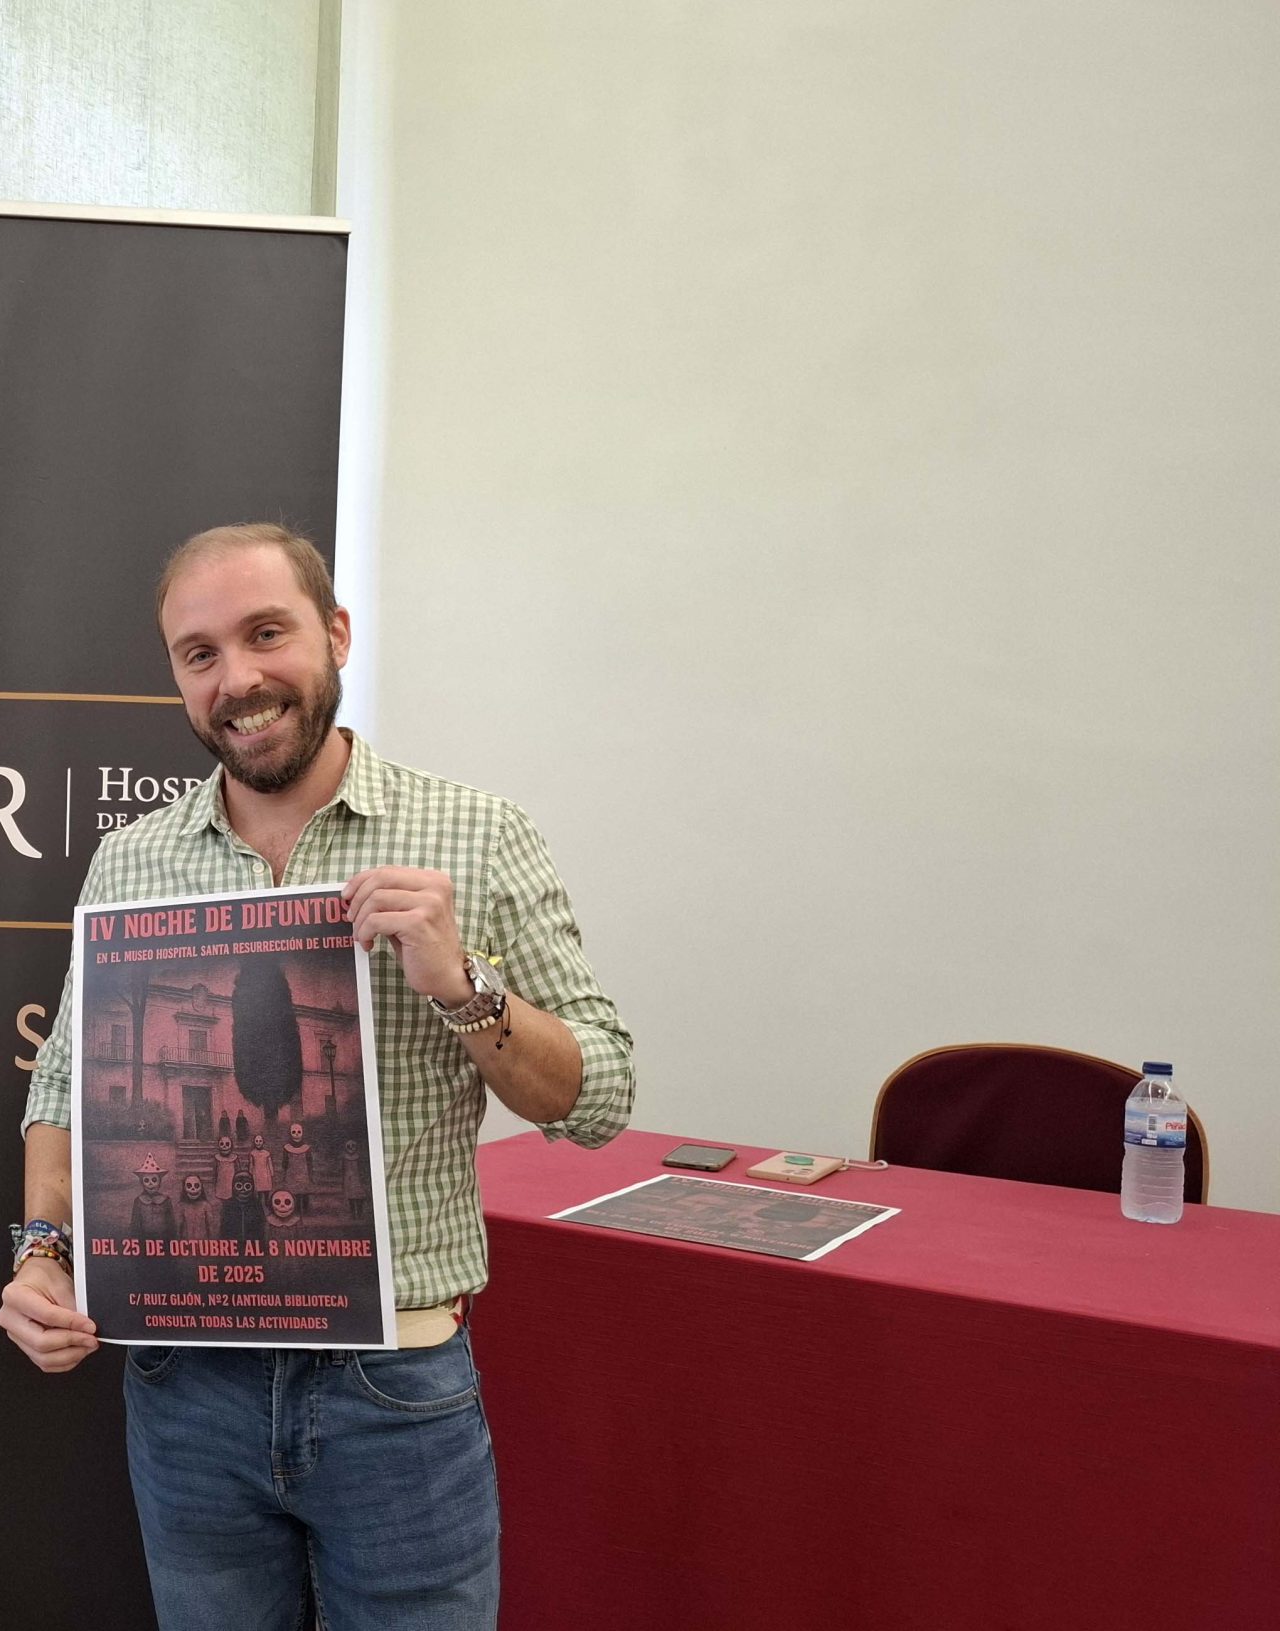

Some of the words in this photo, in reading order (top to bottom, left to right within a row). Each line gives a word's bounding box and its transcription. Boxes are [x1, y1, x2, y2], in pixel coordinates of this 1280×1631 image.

[96, 812, 129, 830] DE
[90, 915, 116, 941] IV
[124, 908, 197, 939] NOCHE
[205, 905, 233, 933] DE
[96, 952, 108, 964] EN
[111, 951, 121, 963] EL
[124, 949, 154, 962] MUSEO
[156, 945, 198, 960] HOSPITAL
[200, 942, 230, 957] SANTA
[233, 936, 303, 954] RESURRECCIÓN
[306, 937, 320, 950] DE
[91, 1238, 119, 1256] DEL
[122, 1239, 140, 1256] 25
[146, 1239, 165, 1256] DE
[169, 1239, 240, 1257] OCTUBRE
[244, 1239, 264, 1257] AL
[268, 1239, 279, 1257] 8
[284, 1239, 372, 1257] NOVEMBRE
[198, 1265, 219, 1283] DE
[223, 1265, 265, 1283] 2025
[129, 1293, 141, 1306] C/
[143, 1293, 168, 1306] RUIZ
[169, 1291, 206, 1308] GIJÓN,
[231, 1294, 282, 1308] (ANTIGUA
[284, 1295, 348, 1309] BIBLIOTECA)
[145, 1315, 197, 1328] CONSULTA
[199, 1315, 233, 1328] TODAS
[236, 1316, 255, 1329] LAS
[258, 1316, 329, 1330] ACTIVIDADES
